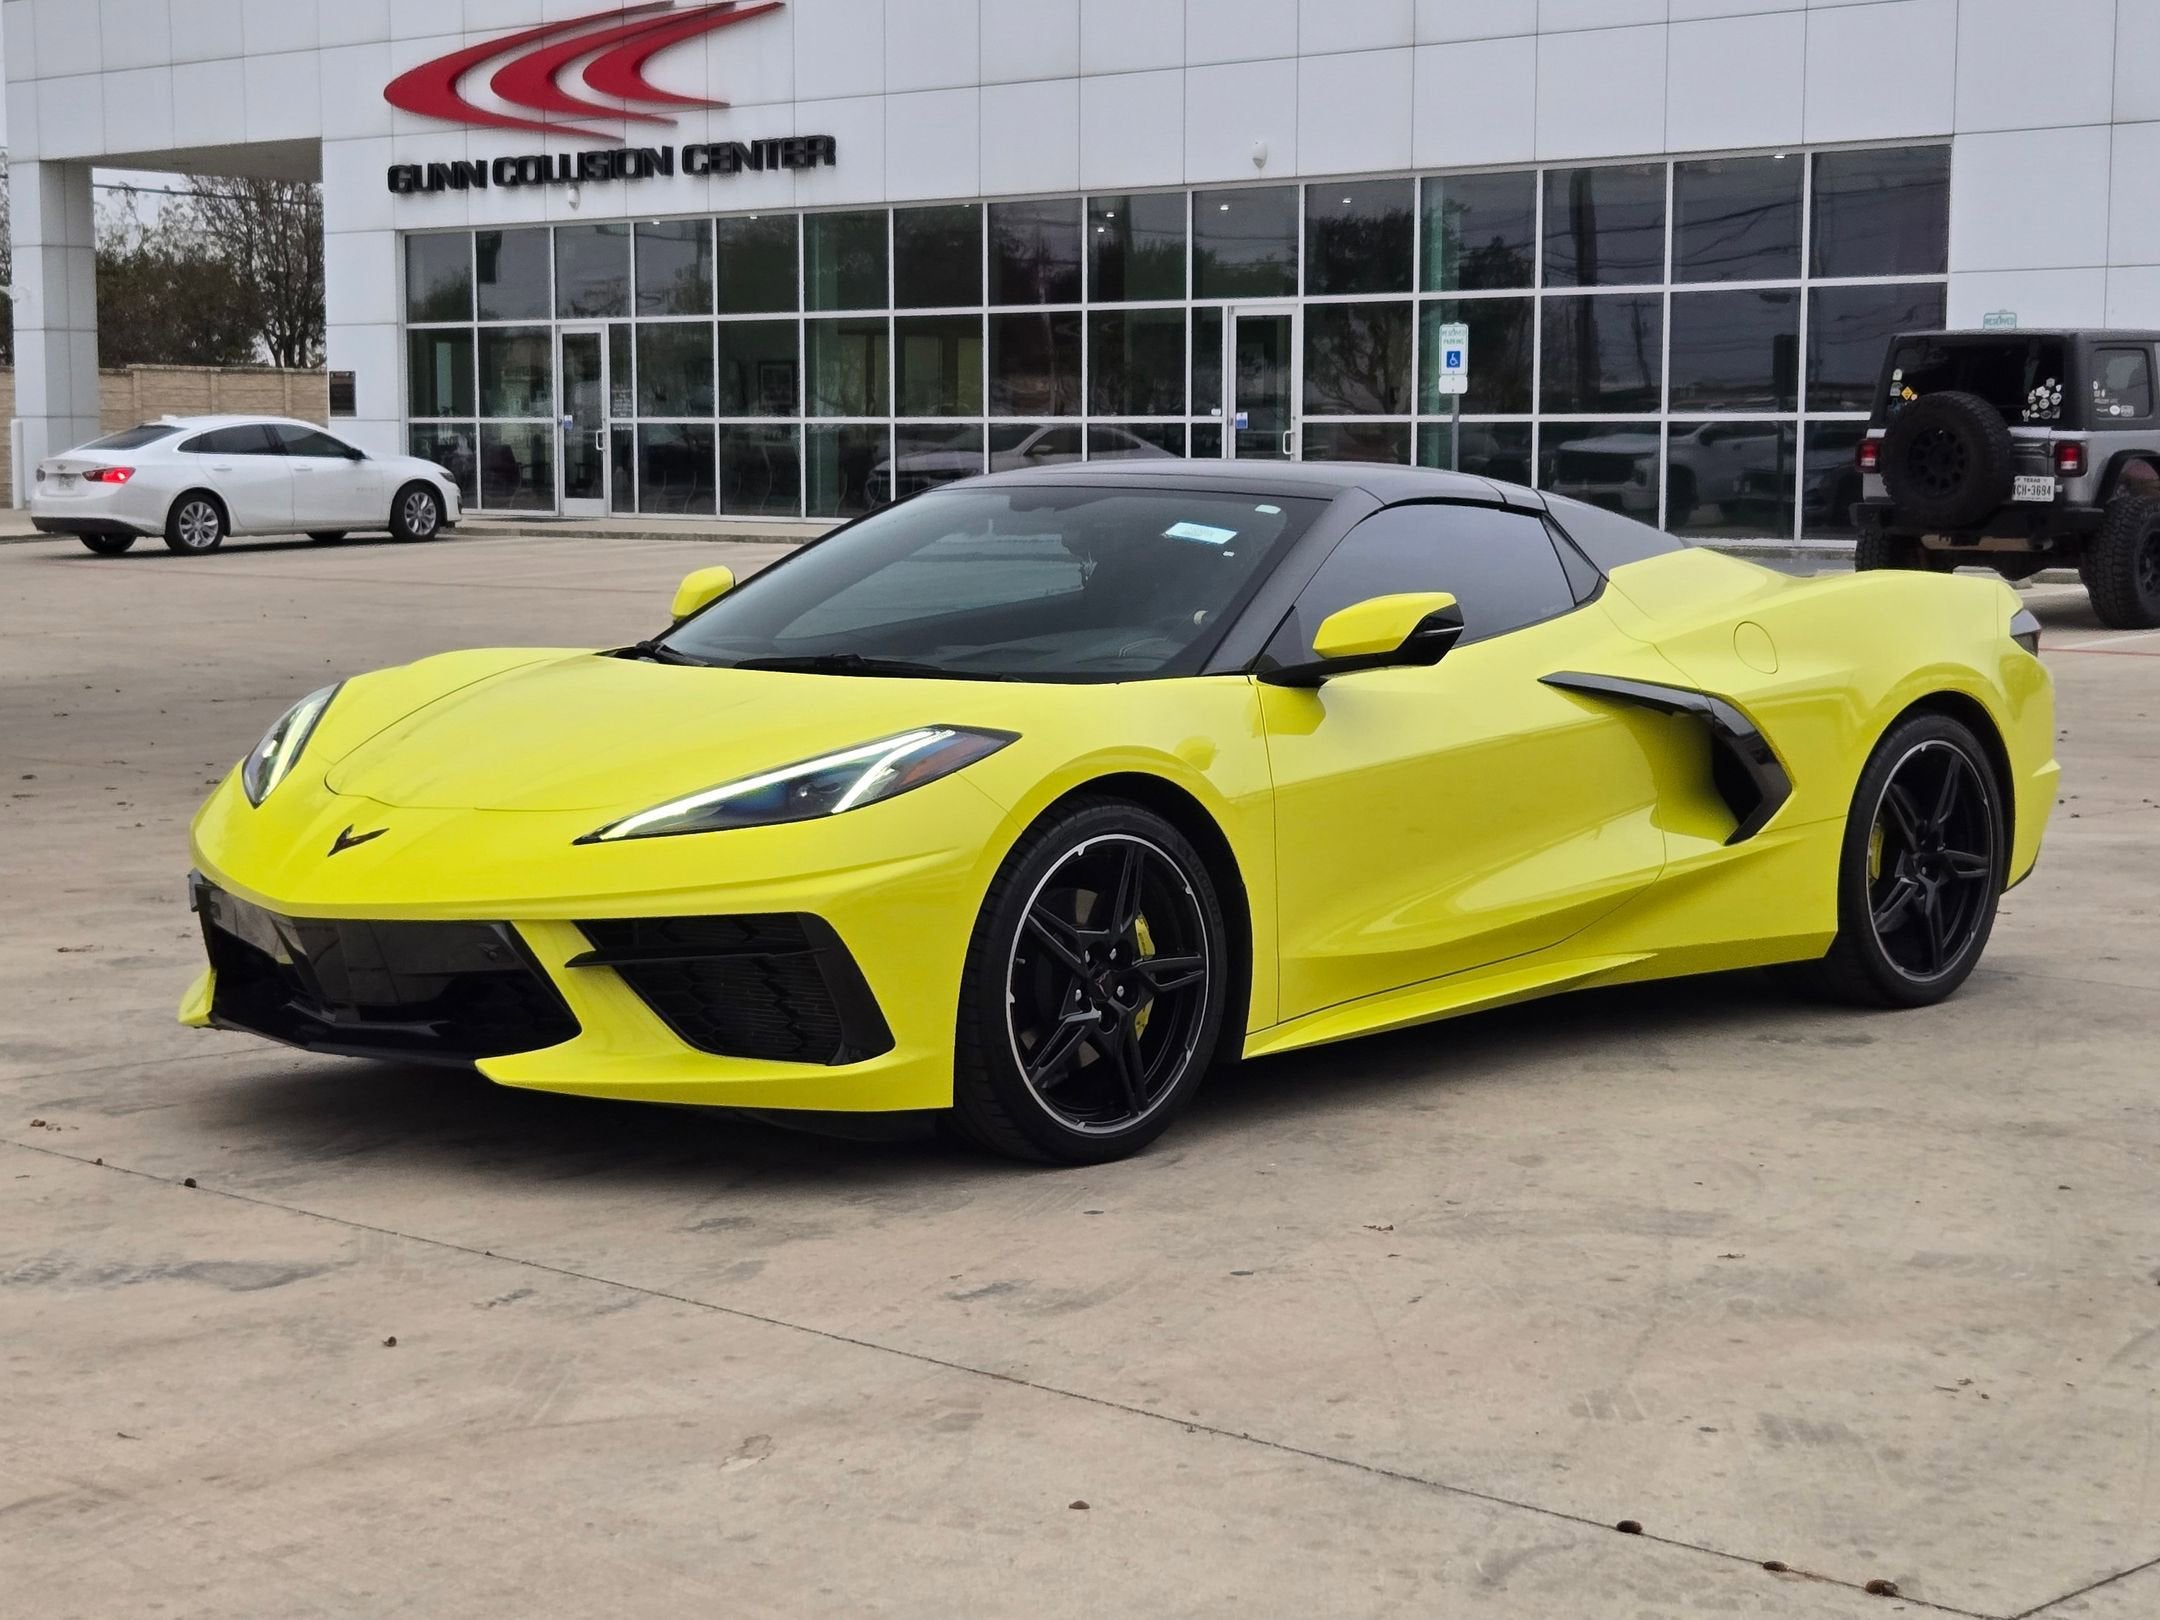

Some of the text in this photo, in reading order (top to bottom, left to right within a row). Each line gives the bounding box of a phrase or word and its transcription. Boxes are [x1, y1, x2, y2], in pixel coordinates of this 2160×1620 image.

[388, 135, 837, 193] GUNN COLLISION CENTER
